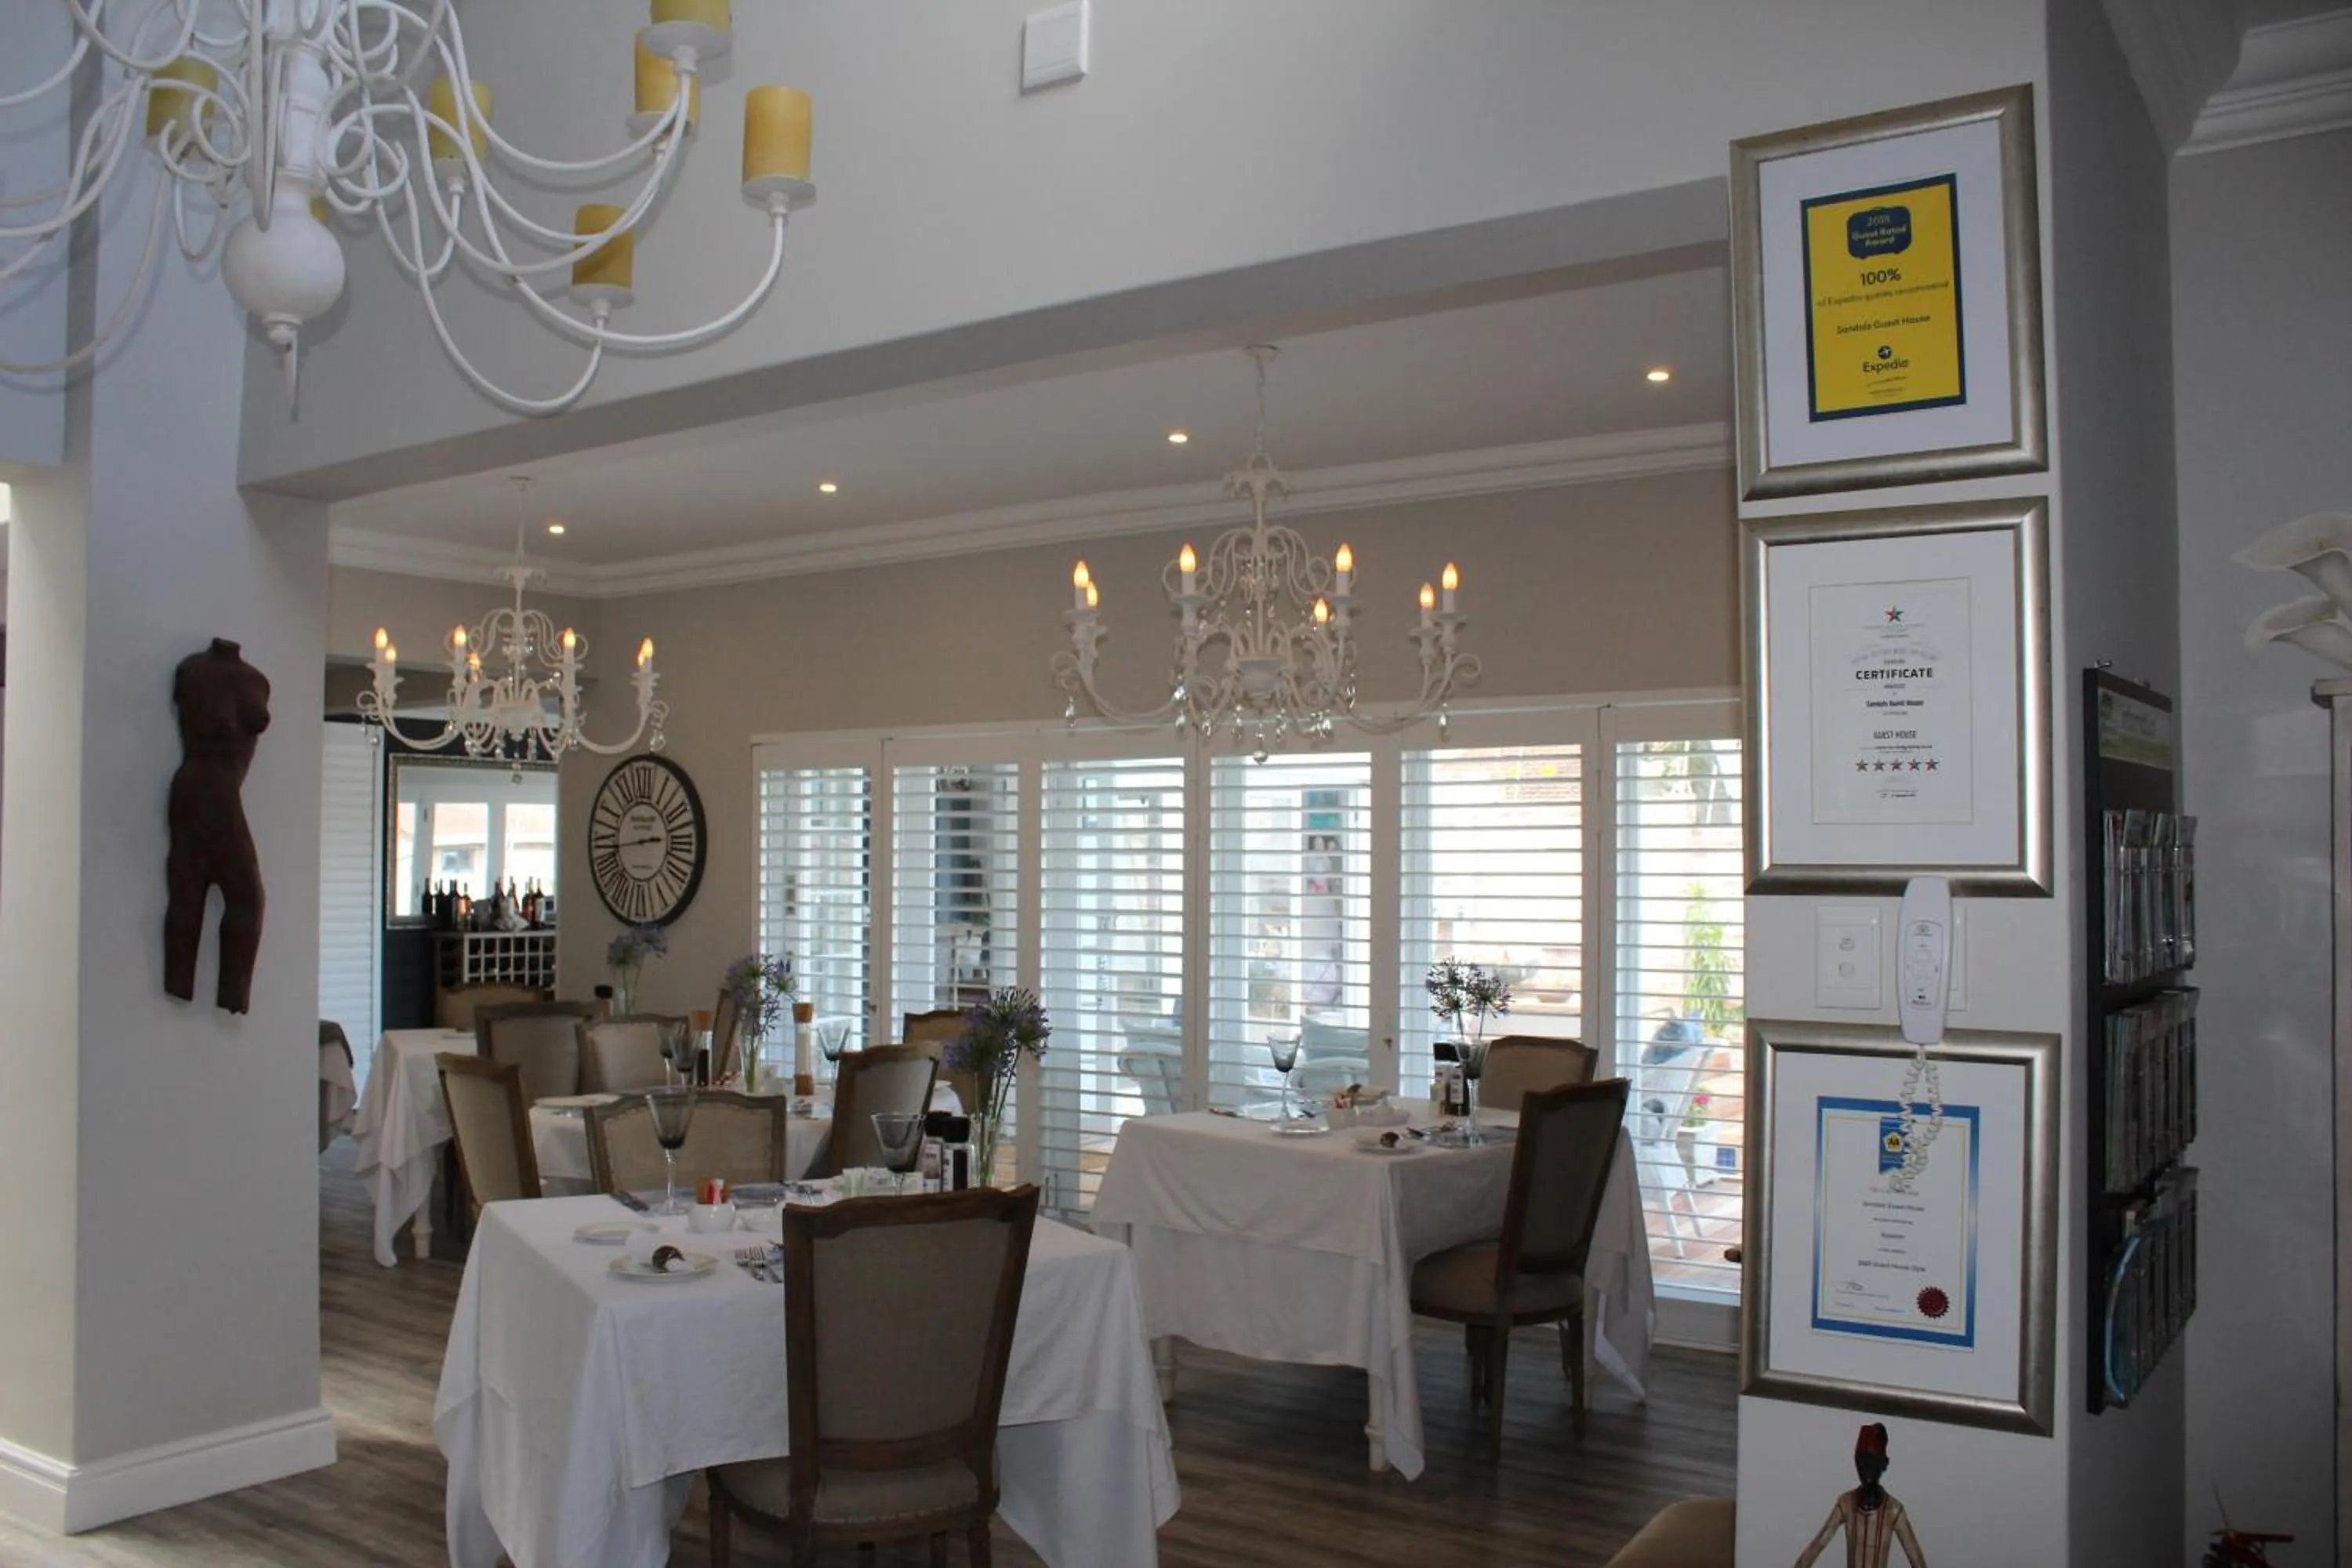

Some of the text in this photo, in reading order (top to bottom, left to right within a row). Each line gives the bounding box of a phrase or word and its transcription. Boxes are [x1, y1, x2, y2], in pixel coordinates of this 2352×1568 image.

[1851, 229, 1878, 241] Guest
[1860, 267, 1901, 287] 100%
[1873, 318, 1900, 328] Guest
[1901, 314, 1931, 325] House
[1862, 358, 1910, 374] Expedia
[1855, 667, 1934, 681] CERTIFICATE
[1873, 730, 1917, 739] GUEST HOUSE
